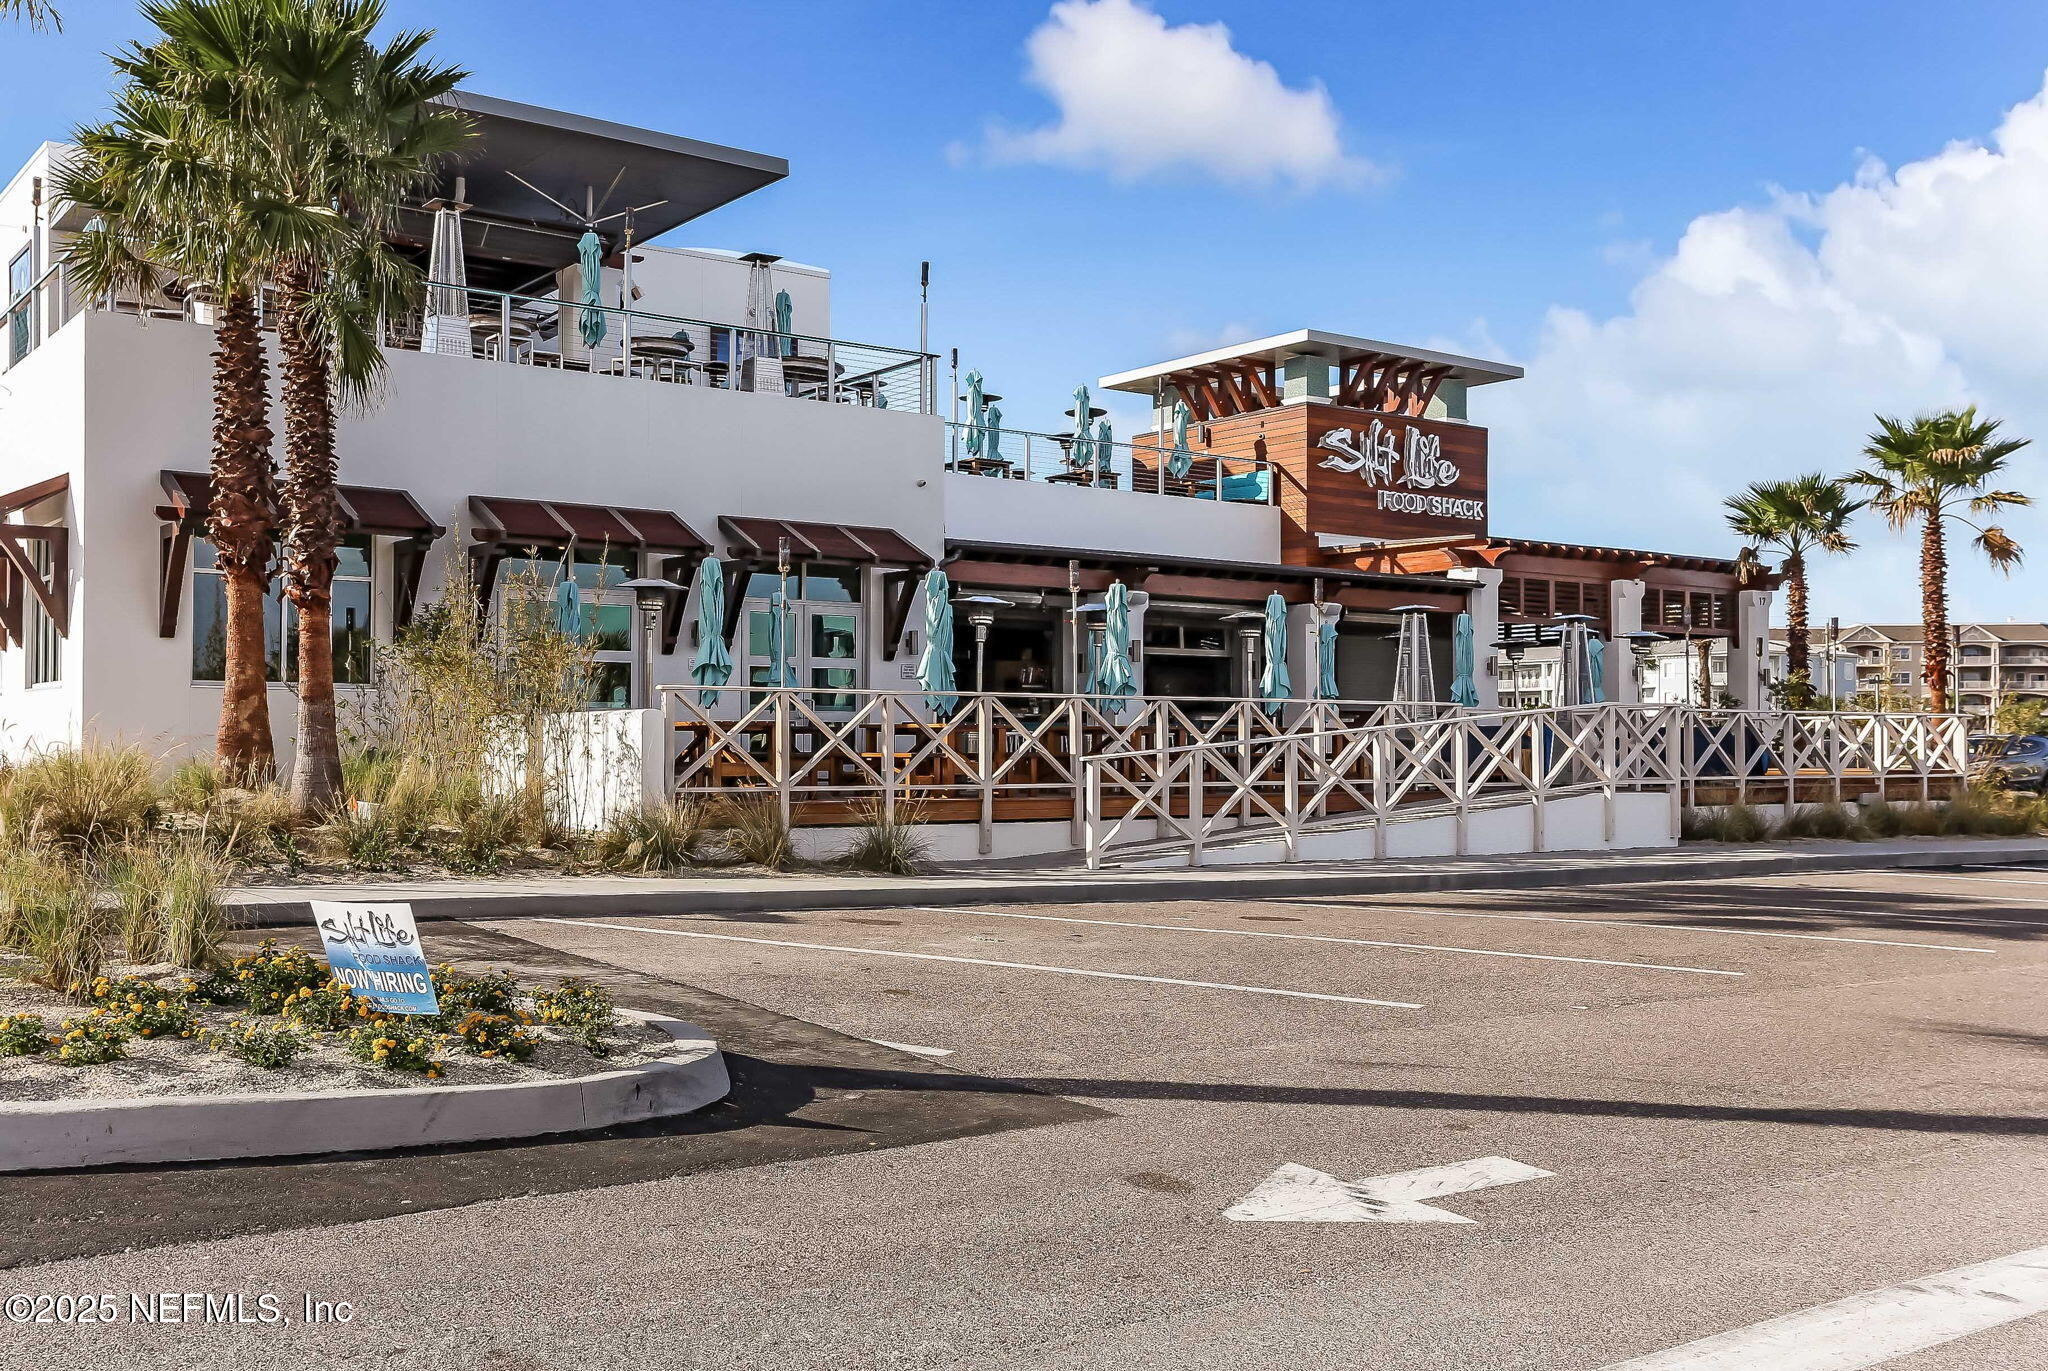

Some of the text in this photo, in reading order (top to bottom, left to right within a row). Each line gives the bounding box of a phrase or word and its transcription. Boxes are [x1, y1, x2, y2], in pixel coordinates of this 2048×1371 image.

[1396, 425, 1460, 489] Life
[1378, 490, 1484, 519] FOOD SHACK
[353, 952, 421, 966] FOOD SHACK
[334, 966, 428, 994] NOW HIRING
